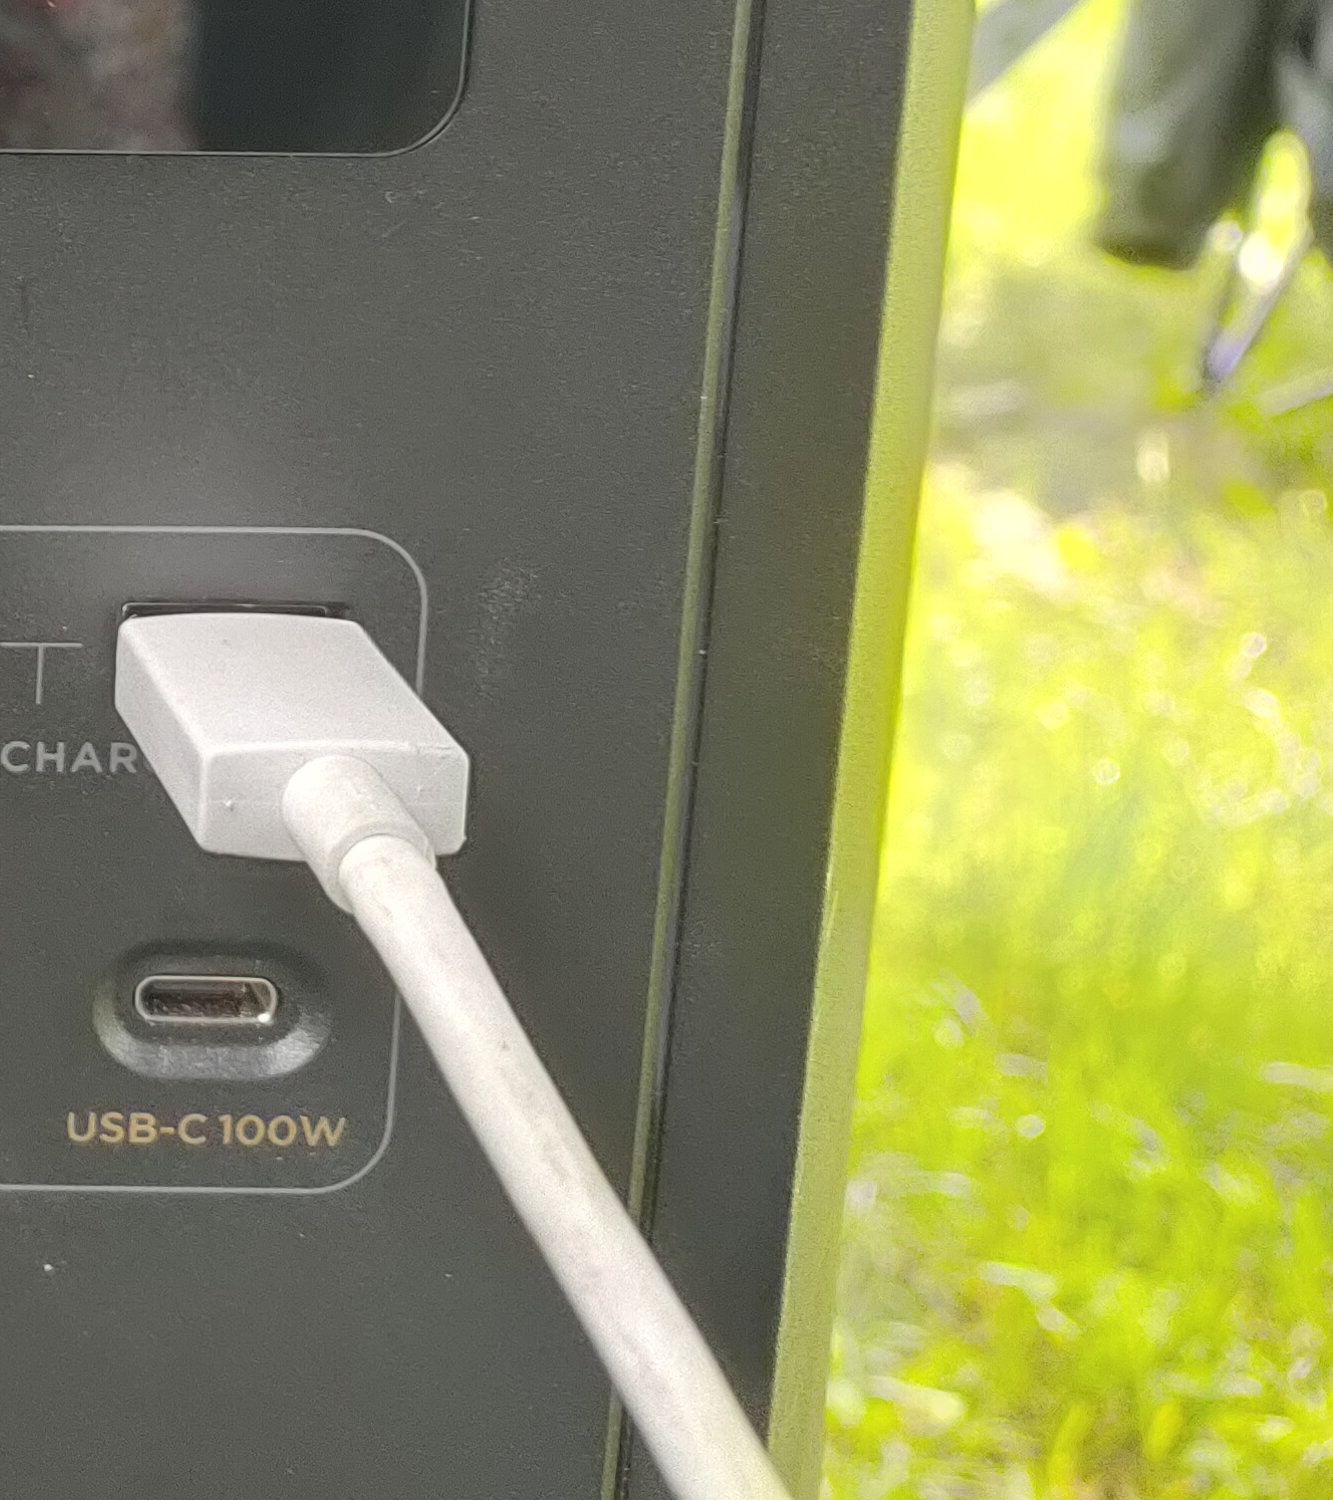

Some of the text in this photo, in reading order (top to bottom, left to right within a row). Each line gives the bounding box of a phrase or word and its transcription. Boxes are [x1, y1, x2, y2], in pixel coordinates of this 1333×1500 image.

[0, 741, 139, 773] CHAR
[66, 1111, 346, 1147] USB-C 100W
